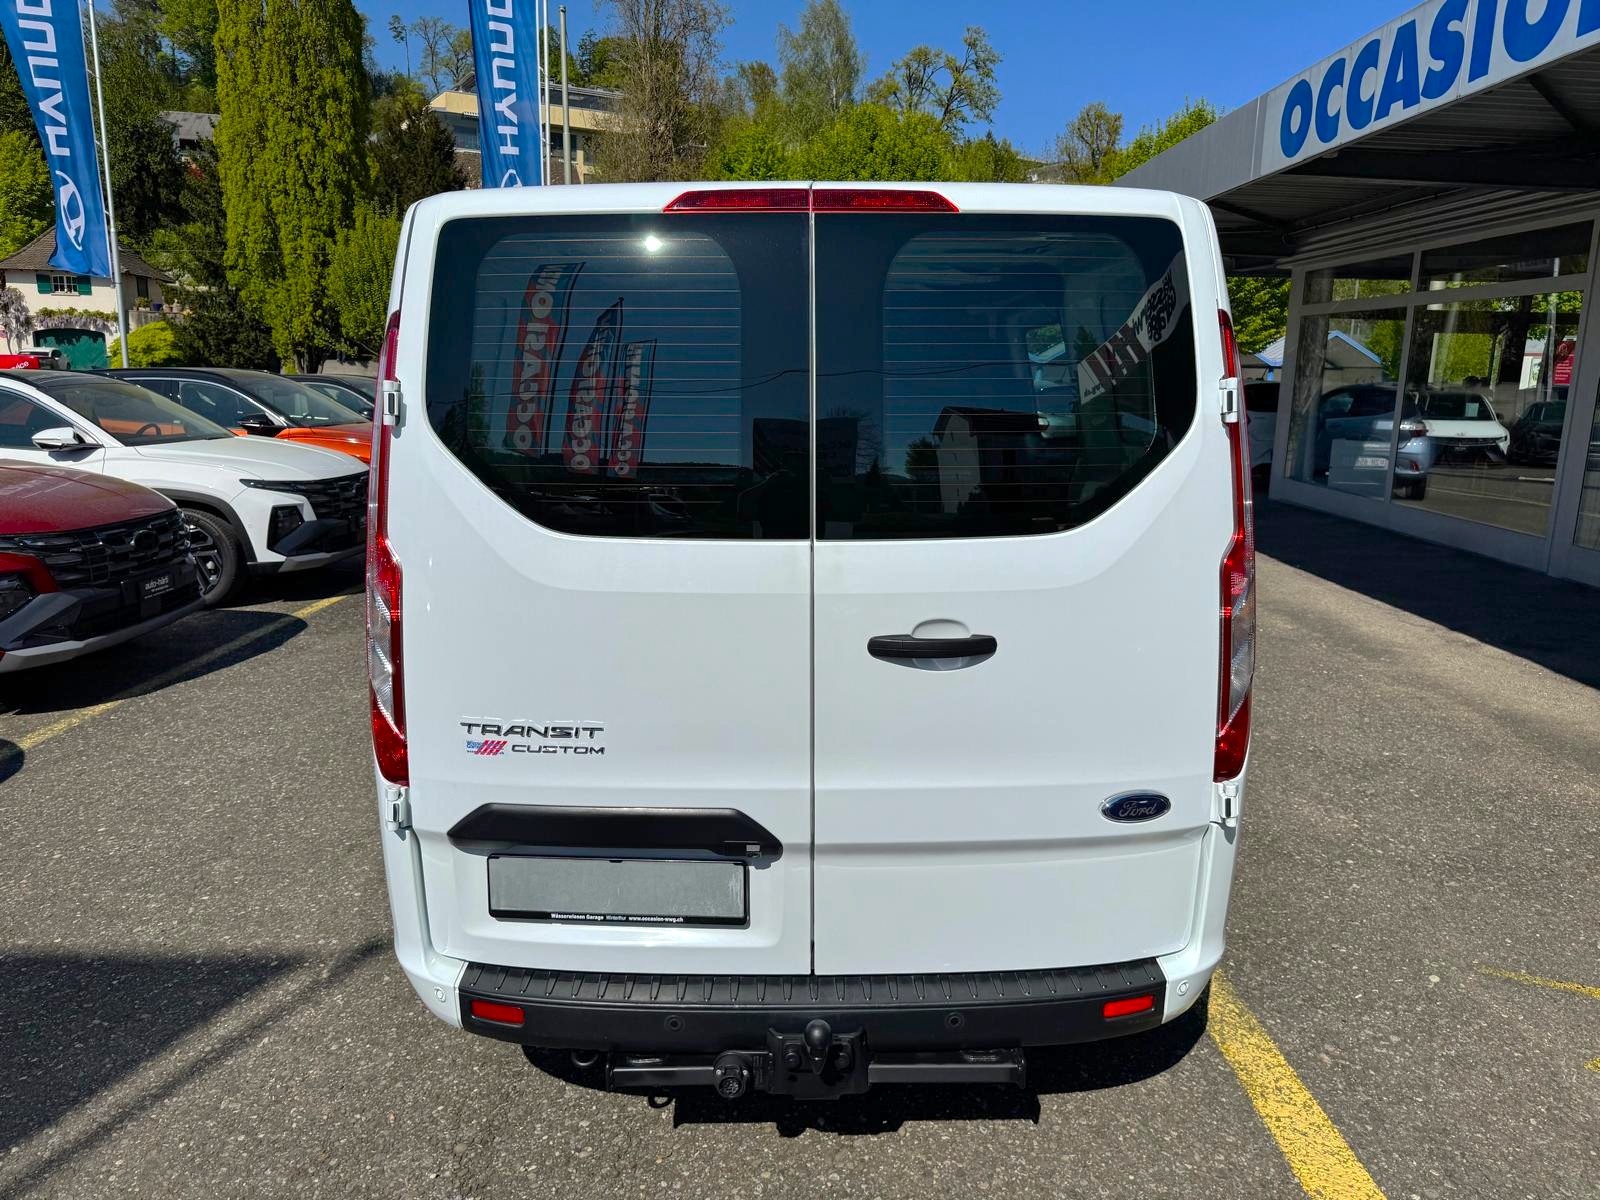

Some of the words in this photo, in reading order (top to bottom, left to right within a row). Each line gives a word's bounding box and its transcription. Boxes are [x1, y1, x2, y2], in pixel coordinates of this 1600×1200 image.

[1279, 0, 1600, 159] OCCASIO
[460, 722, 605, 739] TRANSIT
[511, 744, 605, 755] CUSTOM
[1119, 801, 1157, 818] Ford
